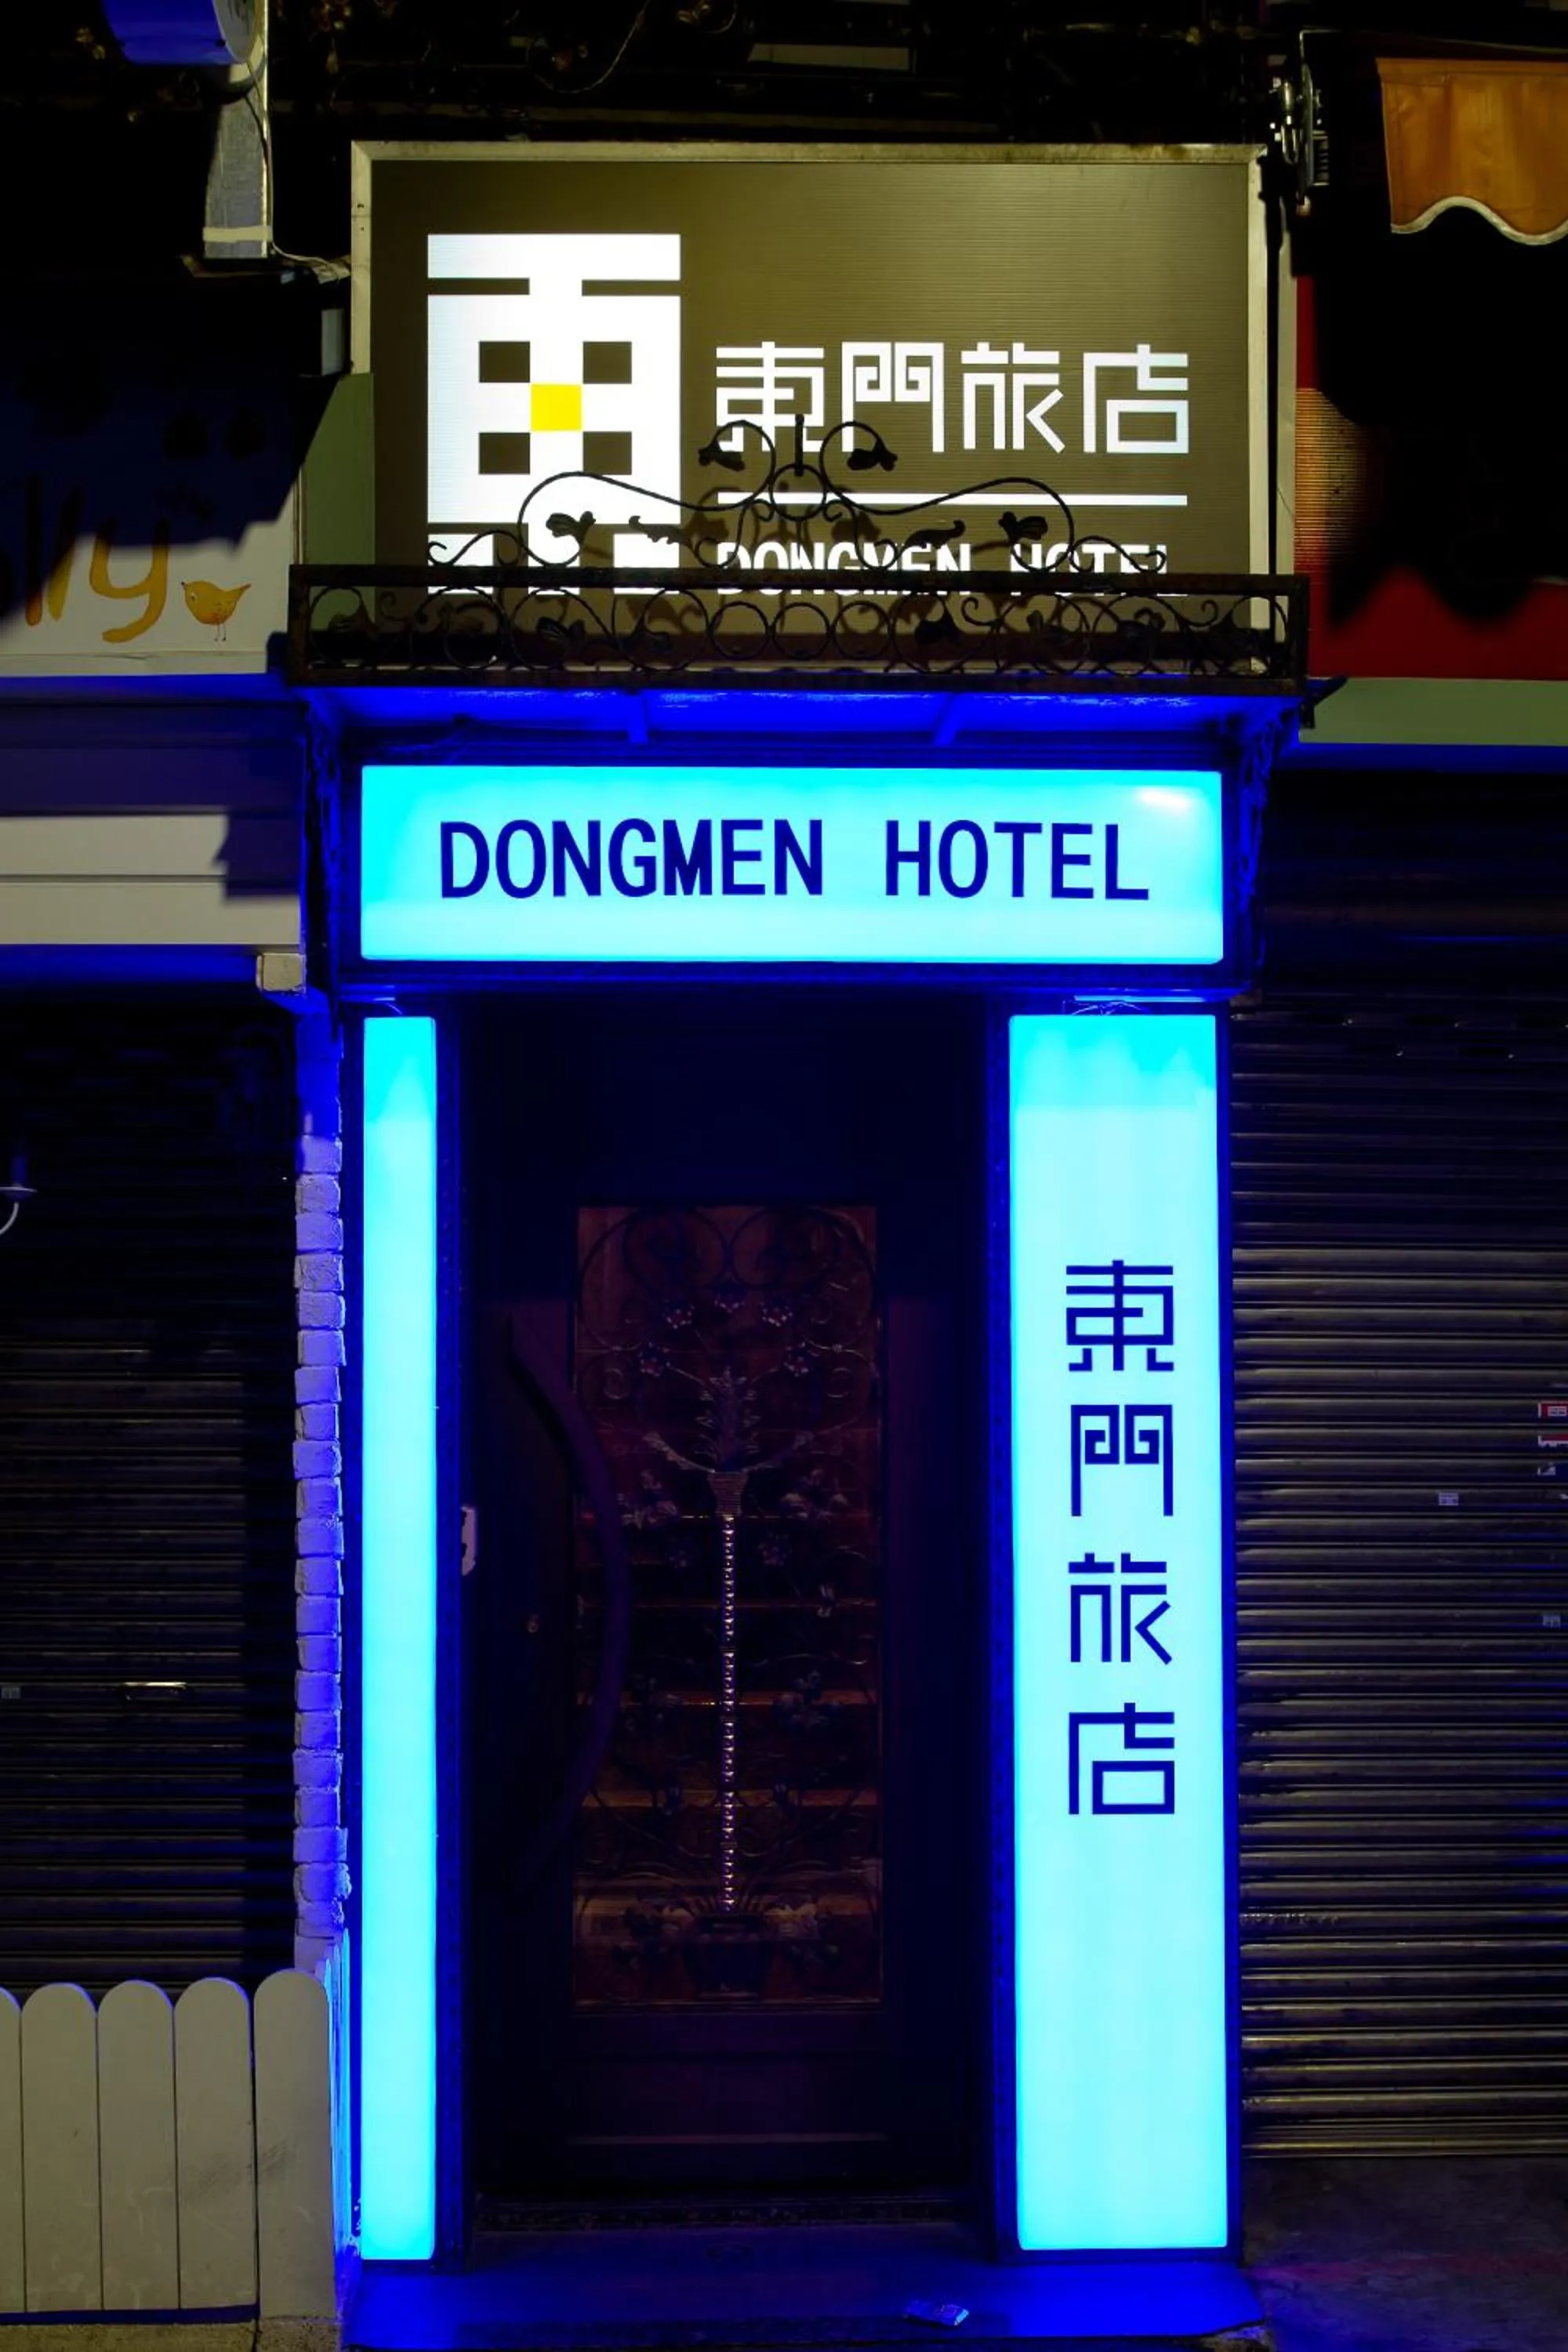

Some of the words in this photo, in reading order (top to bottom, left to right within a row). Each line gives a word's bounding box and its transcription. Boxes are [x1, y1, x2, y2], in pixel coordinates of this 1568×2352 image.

[716, 341, 1189, 454] 東門旅店
[717, 542, 971, 595] DONGMEN
[1011, 543, 1189, 596] HOTEL
[440, 818, 822, 899] DONGMEN
[886, 819, 1149, 901] HOTEL
[1065, 1260, 1175, 1815] 東門旅店
